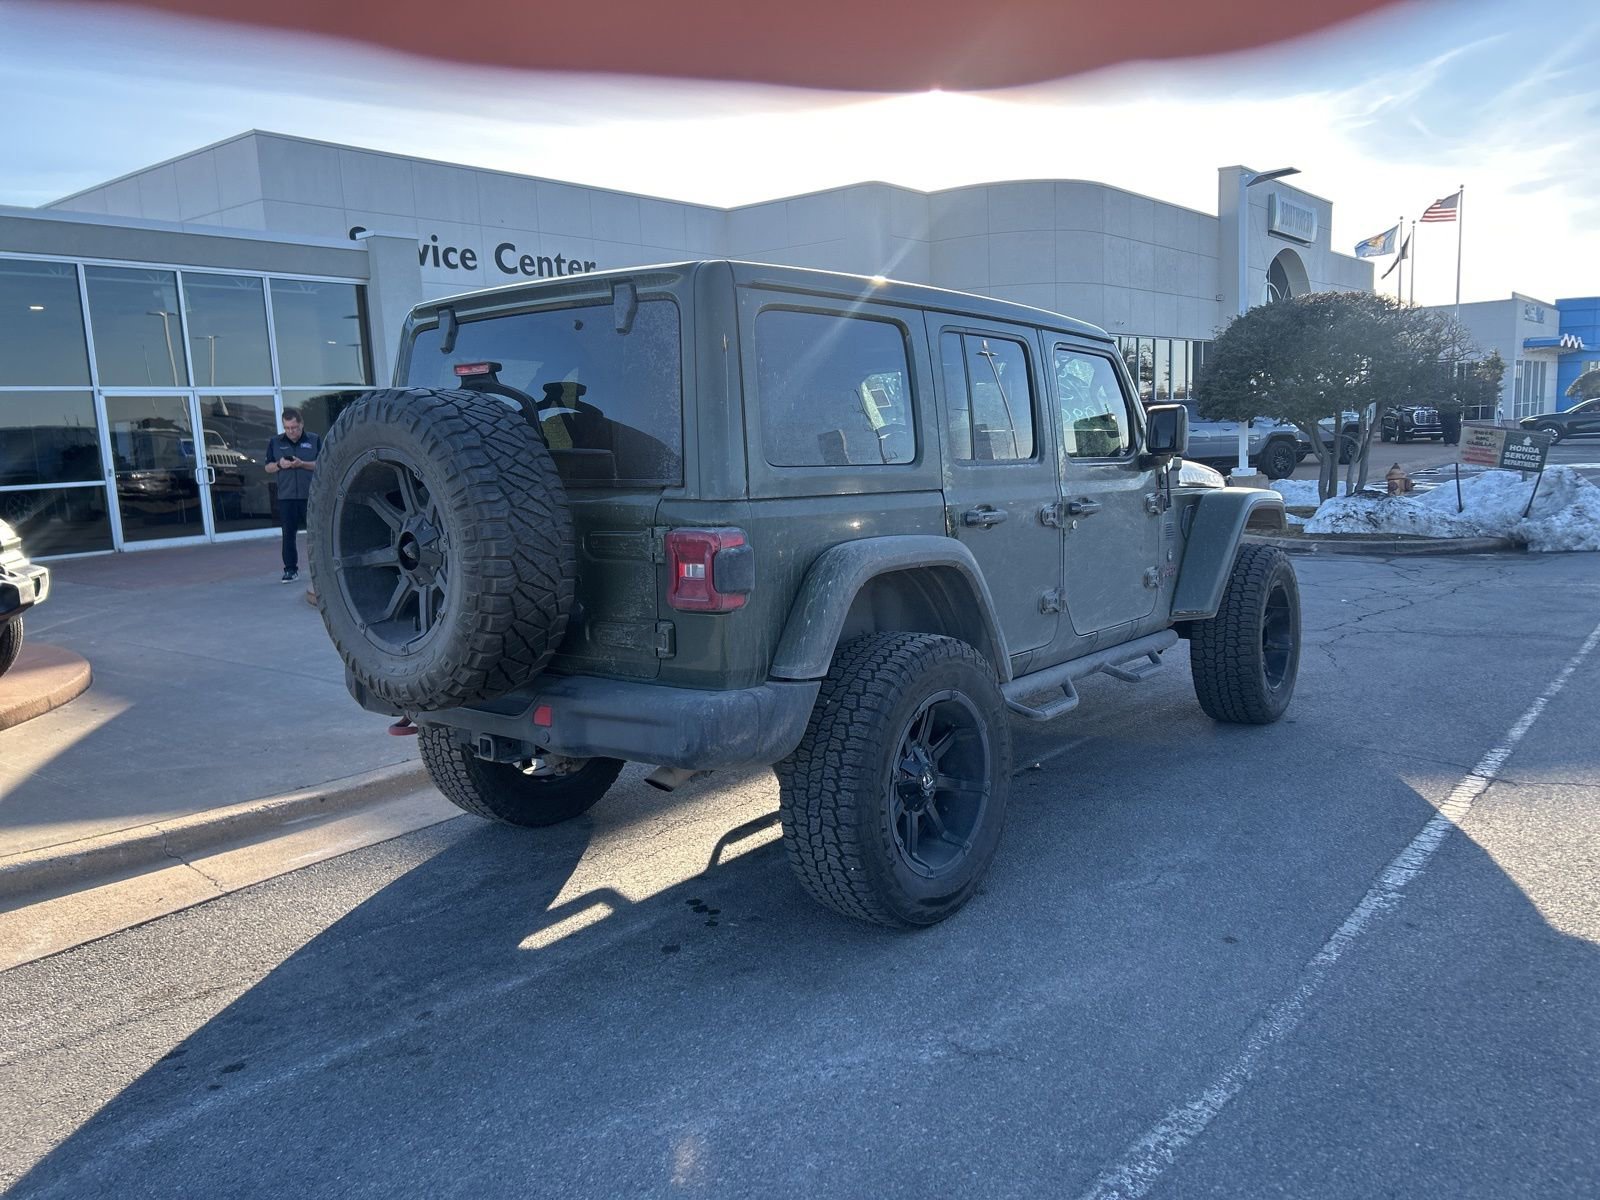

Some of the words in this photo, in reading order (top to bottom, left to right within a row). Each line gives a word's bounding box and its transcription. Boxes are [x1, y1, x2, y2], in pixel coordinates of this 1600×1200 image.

[494, 242, 596, 278] Center
[1509, 444, 1540, 454] HONDA
[1504, 451, 1542, 461] SERVICE
[1503, 459, 1540, 468] DEPARTMENT
